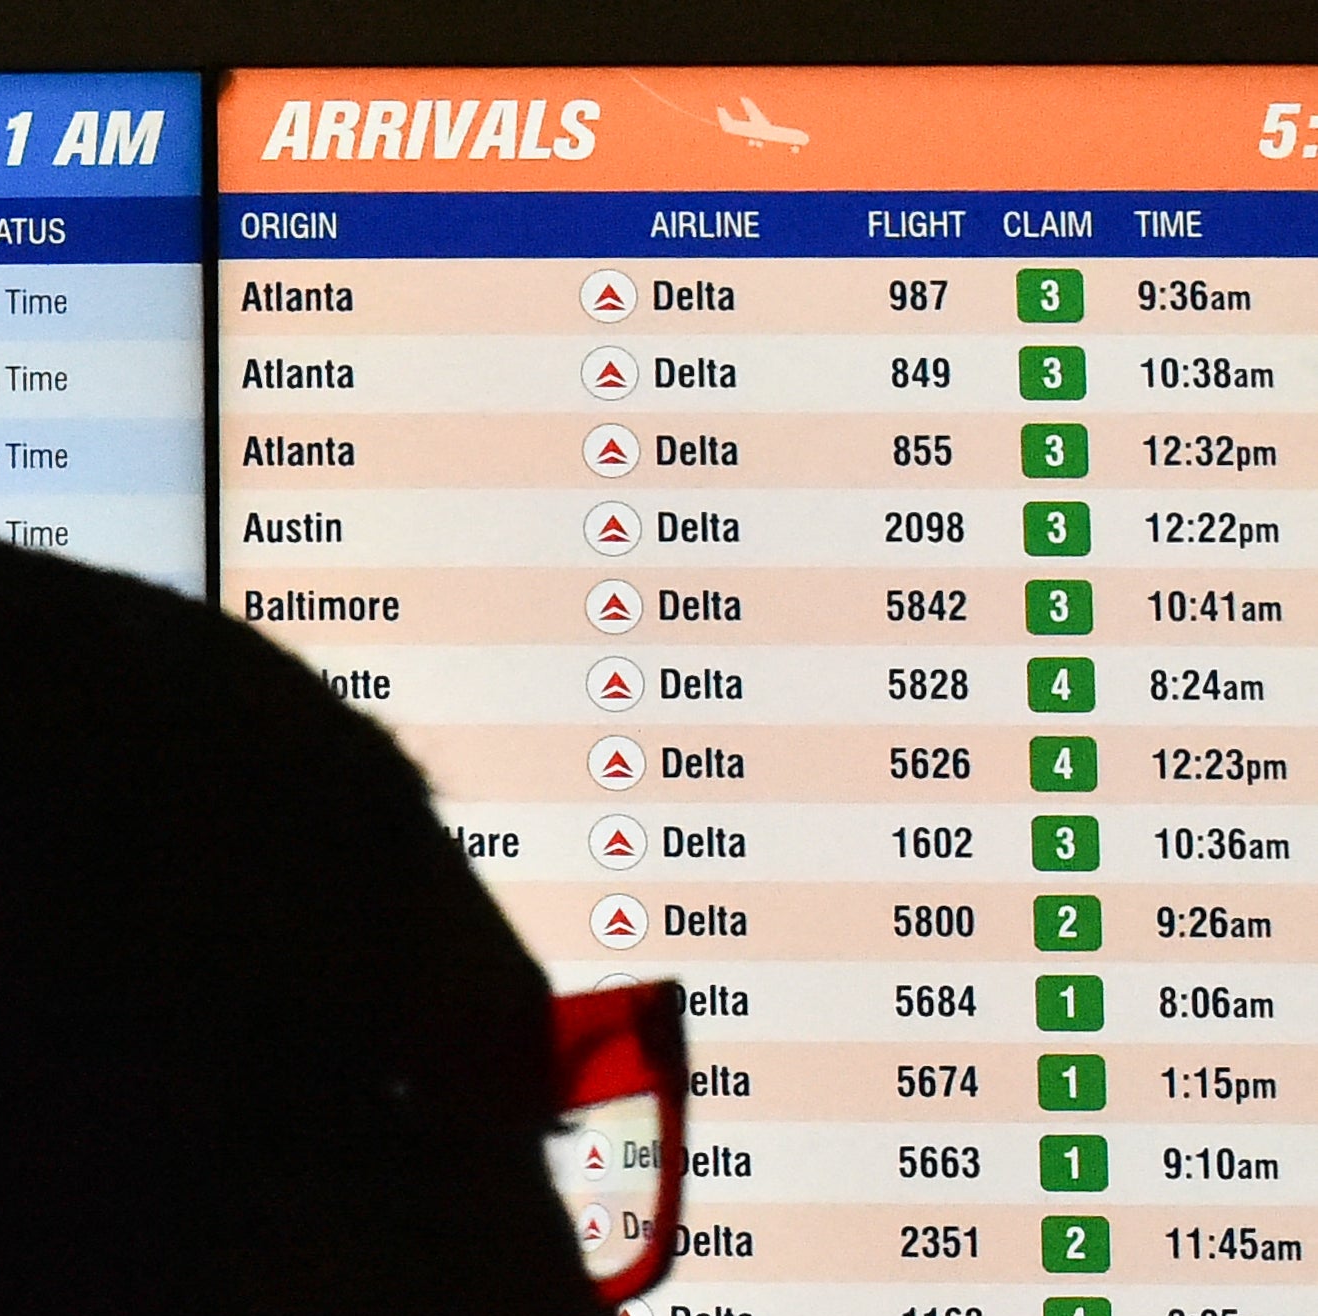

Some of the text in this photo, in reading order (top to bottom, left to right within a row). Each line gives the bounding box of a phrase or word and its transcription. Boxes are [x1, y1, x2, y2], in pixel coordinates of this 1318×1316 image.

[51, 109, 166, 167] AM
[260, 99, 601, 161] ARRIVALS
[240, 209, 1203, 240] ORIGIN AIRLINE FLIGHT CLAIM TIME
[4, 288, 67, 315] Time
[241, 278, 1251, 313] Atlanta Delta 987 3 9:36am
[243, 510, 1279, 550] Austin Delta 2098 3 12:22pm
[660, 667, 1264, 701] Delta 5828 4 8:24am
[663, 826, 1290, 861] Delta 1602 3 10:36am
[623, 1140, 661, 1169] Del
[676, 1223, 753, 1258] Delta
[900, 1225, 978, 1259] 2351
[1065, 1225, 1087, 1260] 2
[1165, 1227, 1302, 1262] 11:45am
